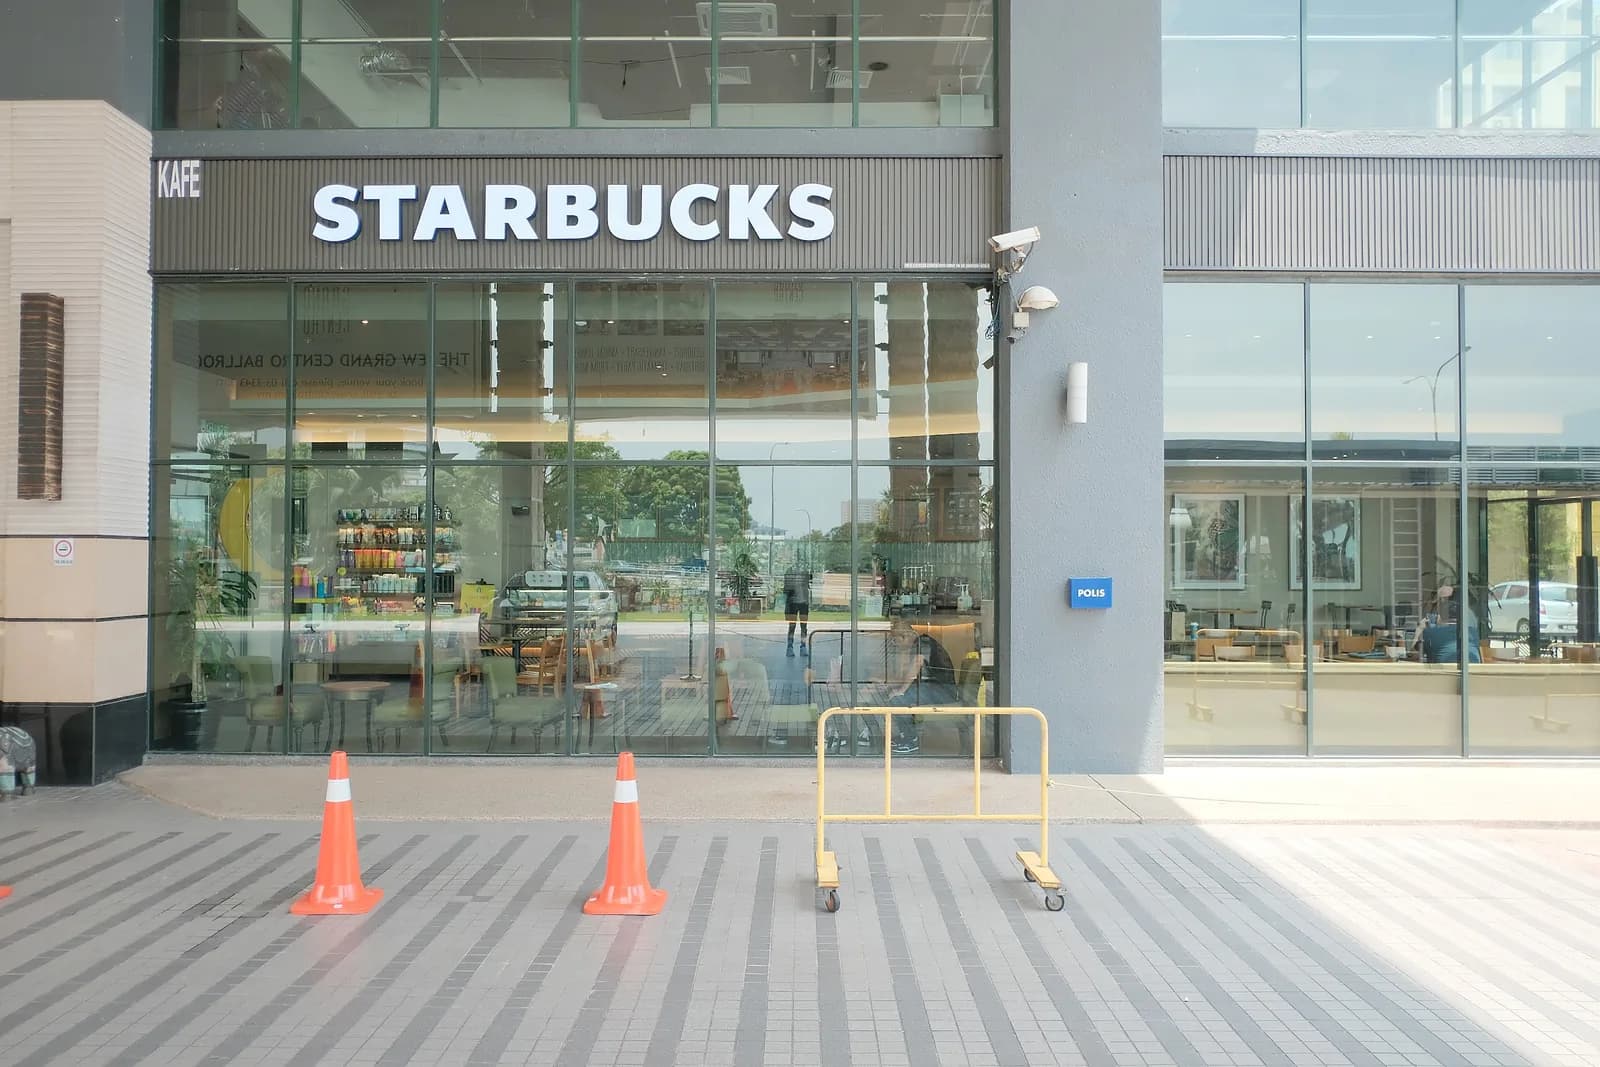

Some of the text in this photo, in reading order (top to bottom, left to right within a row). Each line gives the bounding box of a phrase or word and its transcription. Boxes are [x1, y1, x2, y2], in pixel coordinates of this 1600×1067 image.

[158, 160, 200, 198] KAFE
[312, 183, 835, 242] STARBUCKS
[1077, 588, 1105, 597] POLIS
